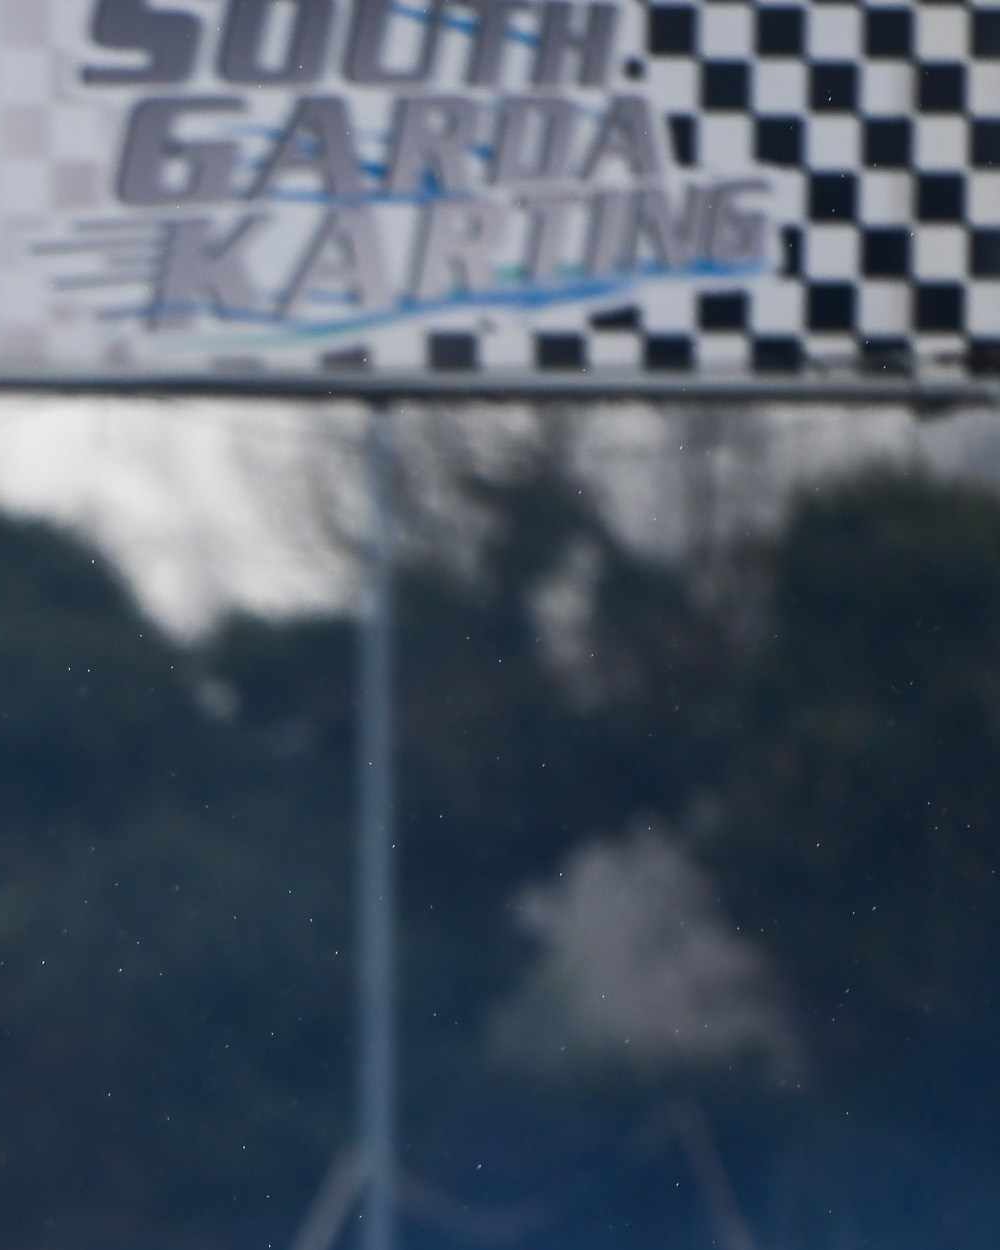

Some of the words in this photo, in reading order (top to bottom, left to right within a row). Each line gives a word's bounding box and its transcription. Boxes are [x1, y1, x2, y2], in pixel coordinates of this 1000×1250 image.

[80, 0, 622, 86] SOUTH
[113, 94, 673, 205] GARDA
[145, 178, 773, 328] KARTING
